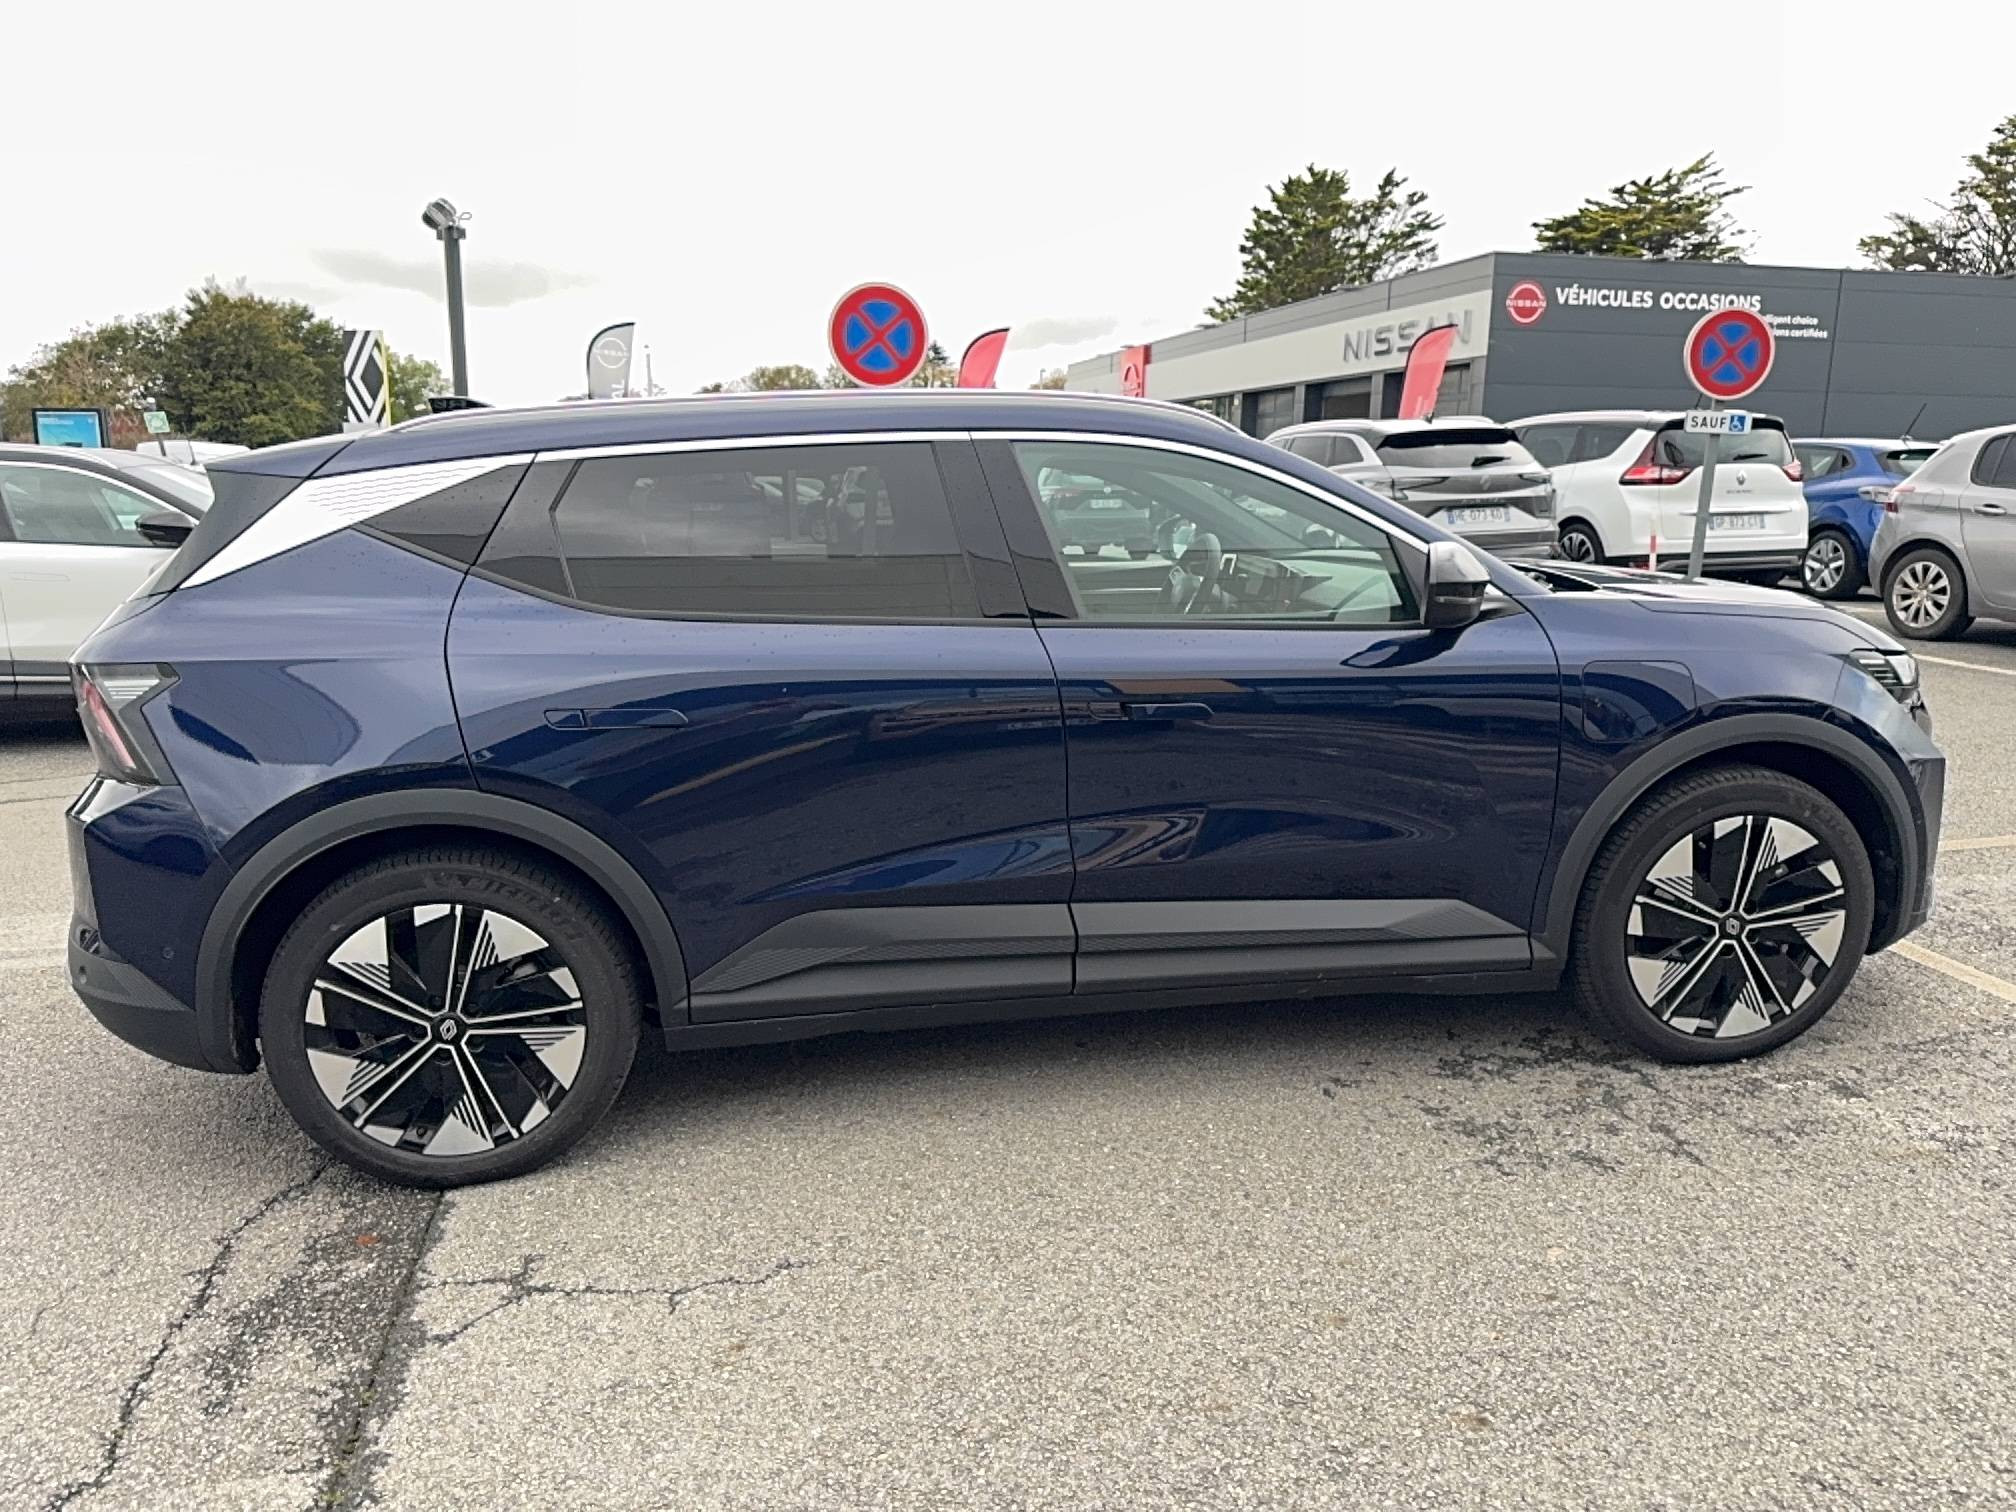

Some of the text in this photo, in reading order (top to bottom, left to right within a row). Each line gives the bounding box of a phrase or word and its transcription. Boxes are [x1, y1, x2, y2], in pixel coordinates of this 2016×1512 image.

[1506, 299, 1547, 308] NISSAN
[1555, 284, 1761, 312] VÉHICULES OCCASIONS
[1791, 315, 1819, 325] choice
[1691, 415, 1727, 429] SAUF
